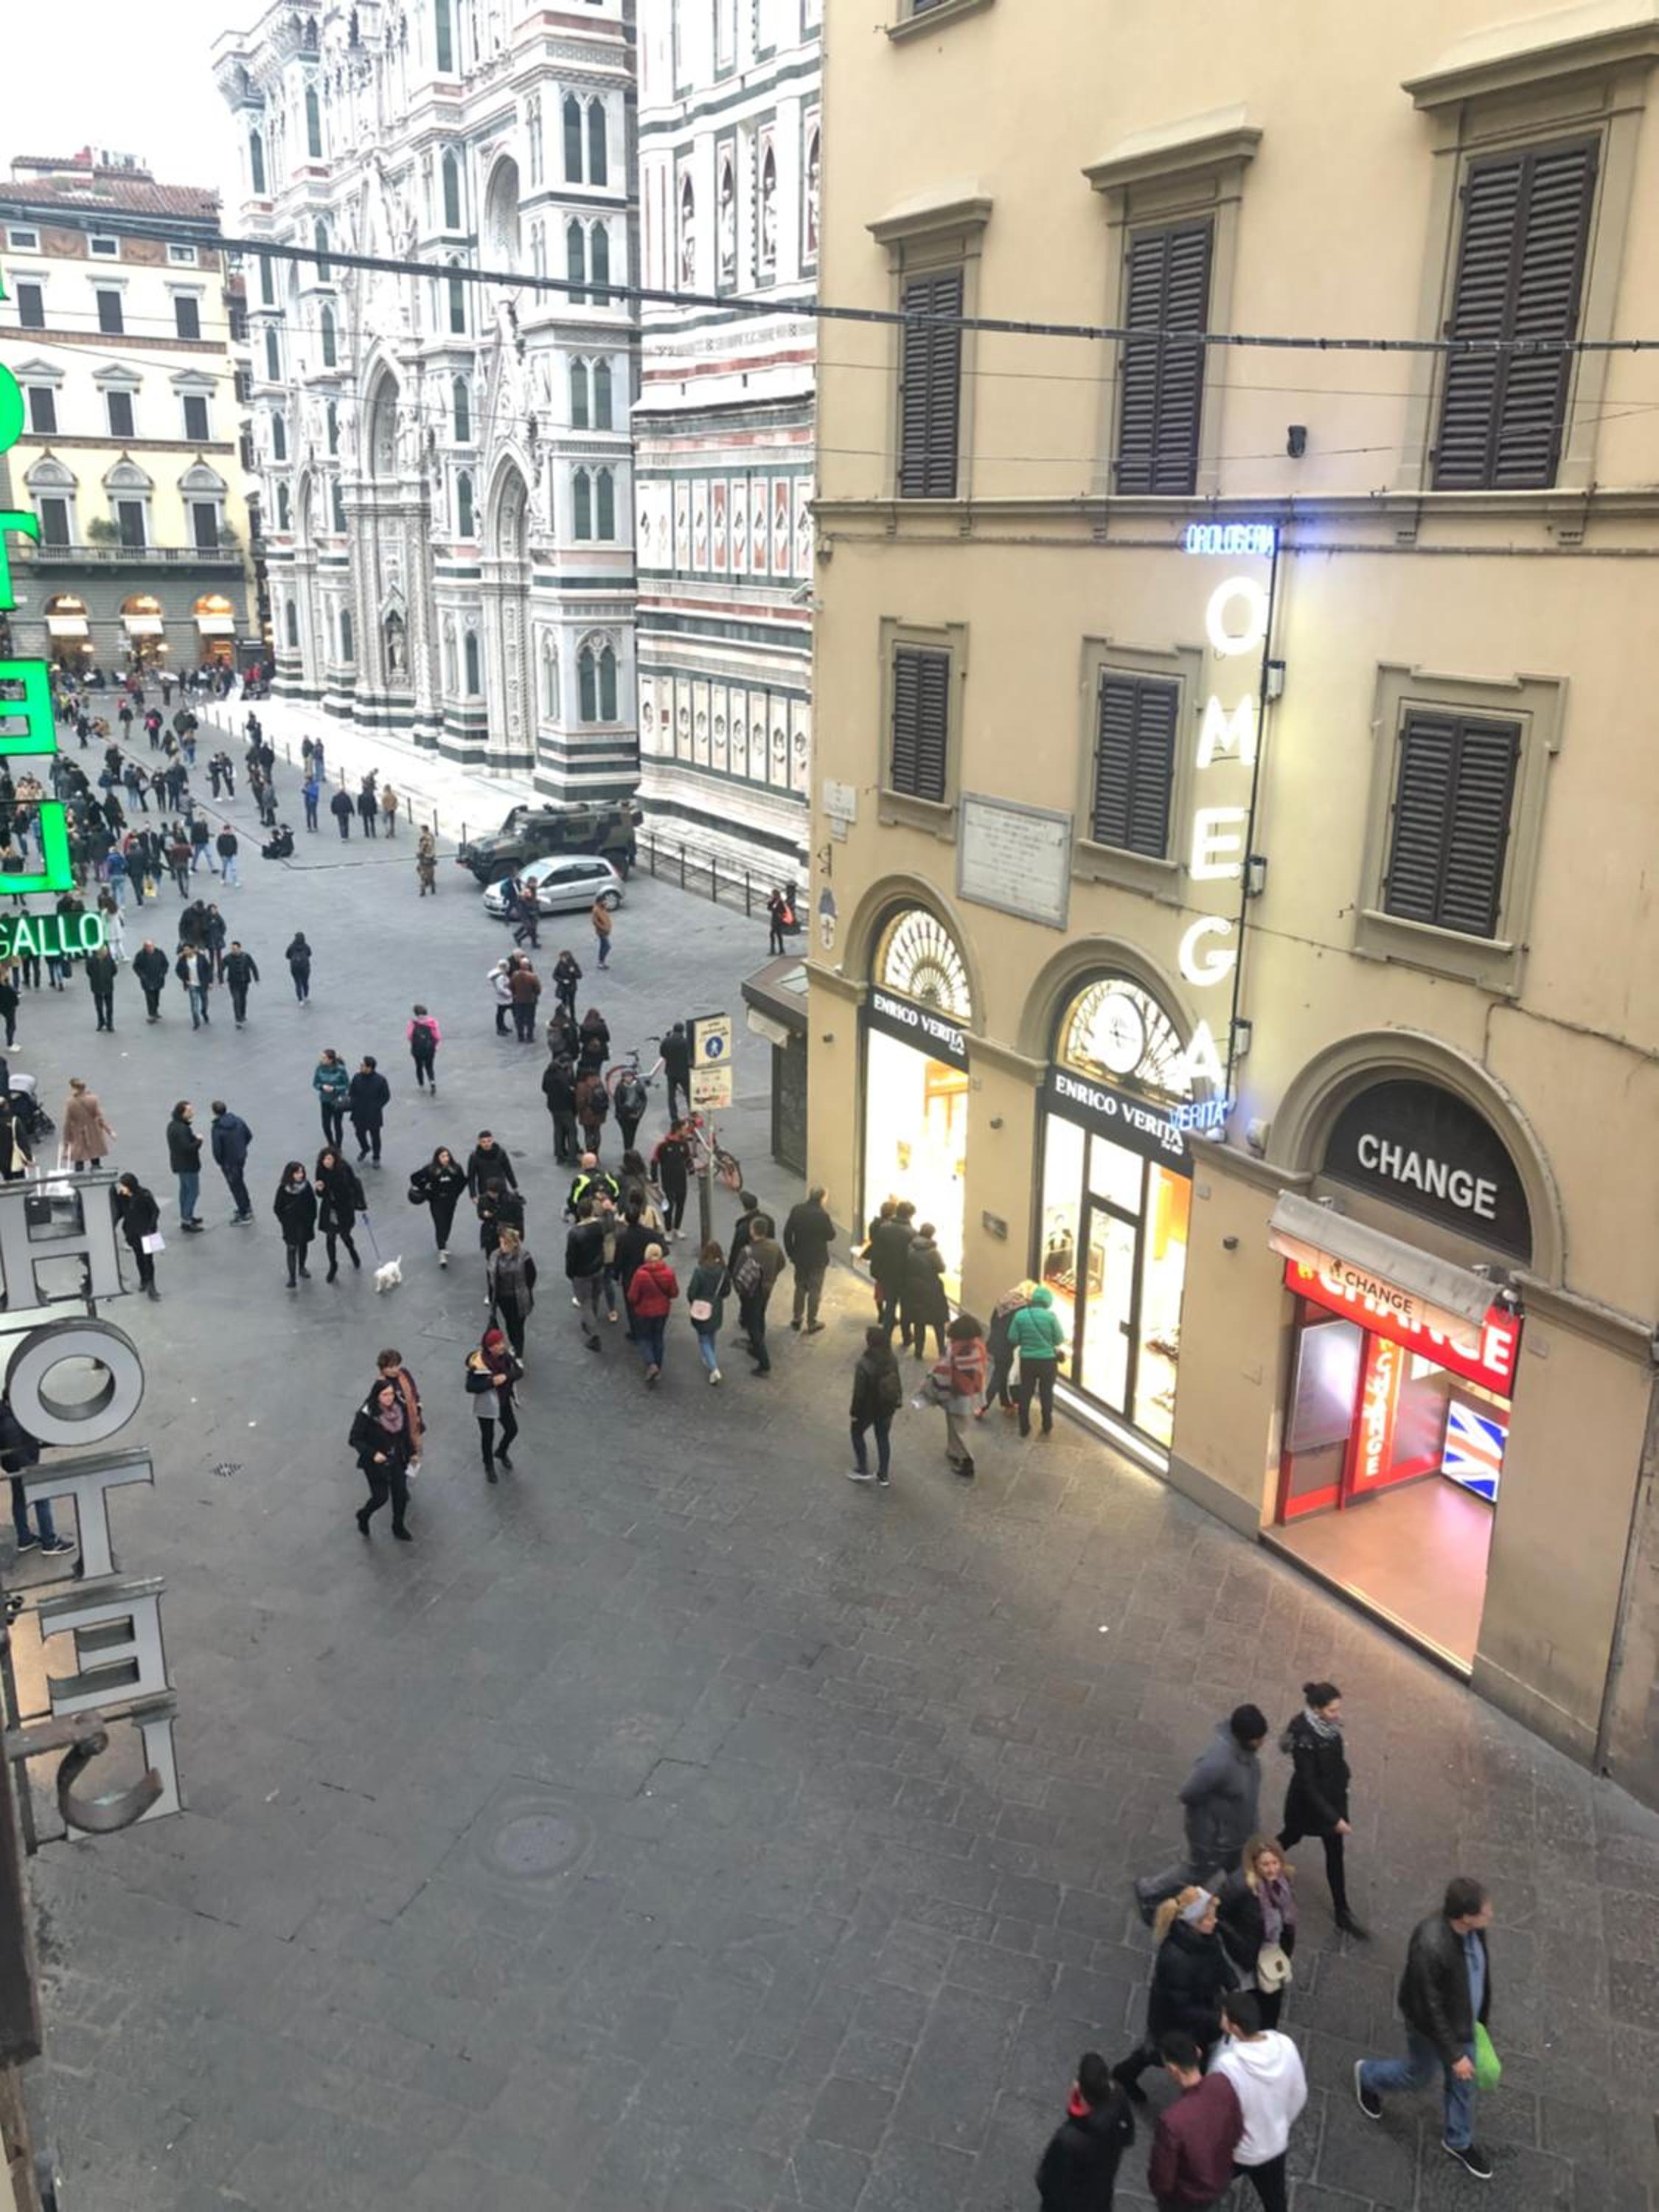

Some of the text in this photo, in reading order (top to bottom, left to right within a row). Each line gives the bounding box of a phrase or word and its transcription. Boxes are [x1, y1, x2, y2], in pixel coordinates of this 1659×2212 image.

[1178, 576, 1269, 1093] OMEGA
[874, 993, 919, 1027] ENRICO
[1055, 1074, 1118, 1116] ENRICO
[1357, 1133, 1498, 1220] CHANGE
[1345, 1271, 1413, 1315] CHANGE
